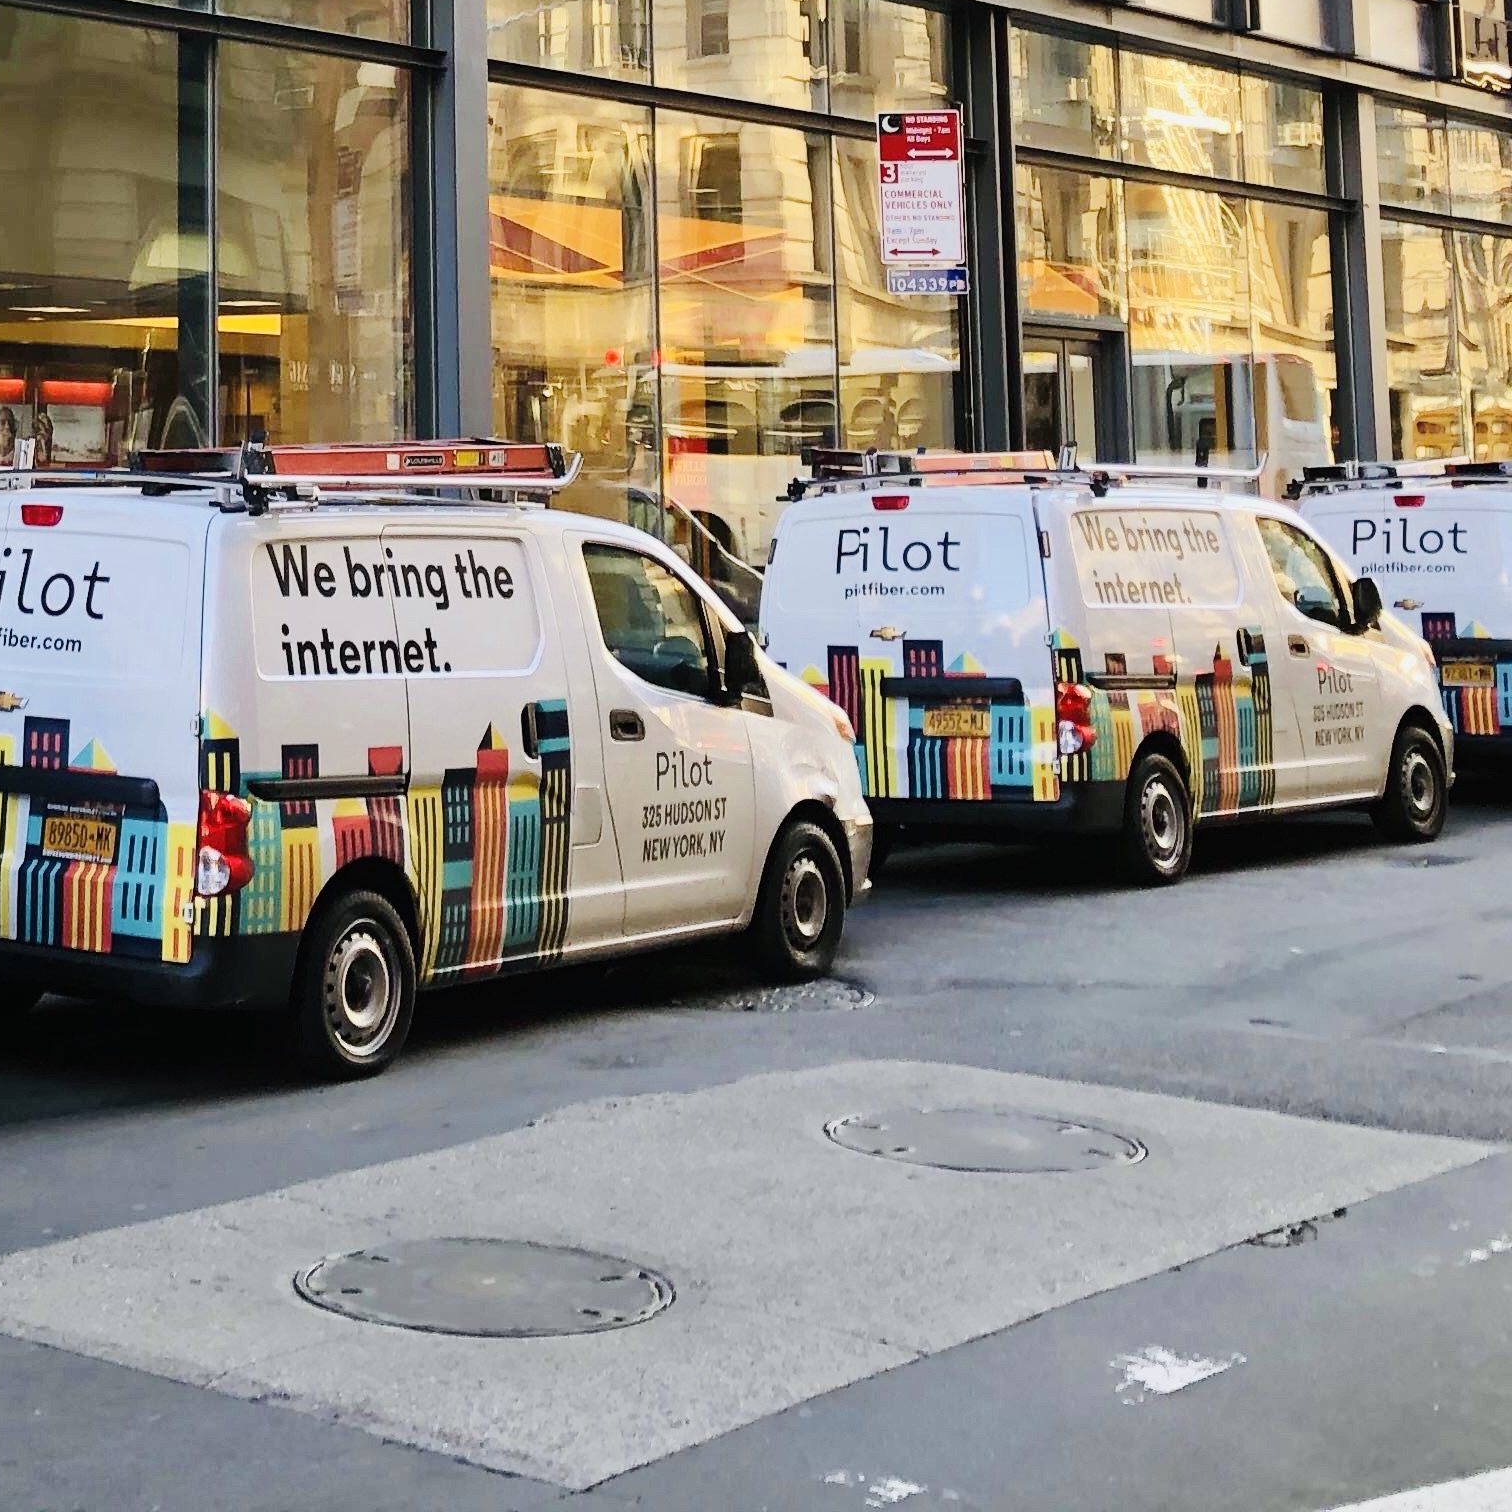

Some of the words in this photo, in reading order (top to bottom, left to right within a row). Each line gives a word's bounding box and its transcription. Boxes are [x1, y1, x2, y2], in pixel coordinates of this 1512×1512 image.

[905, 115, 916, 124] NO
[917, 115, 949, 124] STANDING
[882, 162, 897, 183] 3
[884, 190, 944, 199] COMMERCIAL
[885, 200, 928, 209] VEHICLES
[930, 200, 954, 209] ONLY
[912, 214, 922, 222] NO
[891, 276, 948, 292] 104339
[836, 525, 961, 575] Pilot
[1075, 513, 1120, 552] We
[1118, 516, 1185, 561] bring
[1182, 518, 1220, 554] the
[1352, 517, 1468, 556] Pilot
[265, 543, 337, 598] We
[342, 545, 450, 610] bring
[454, 549, 514, 600] the
[1361, 561, 1456, 576] pilotfiber.com
[1093, 568, 1193, 605] internet.
[281, 623, 452, 676] internet.
[1317, 665, 1355, 696] Pilot
[1314, 730, 1332, 747] NEW
[656, 750, 713, 792] Pilot
[642, 804, 662, 829] 325
[664, 799, 712, 826] HUDSON
[714, 797, 727, 821] ST
[642, 836, 671, 863] NEW
[672, 832, 707, 858] YORK,
[709, 829, 726, 854] NY
